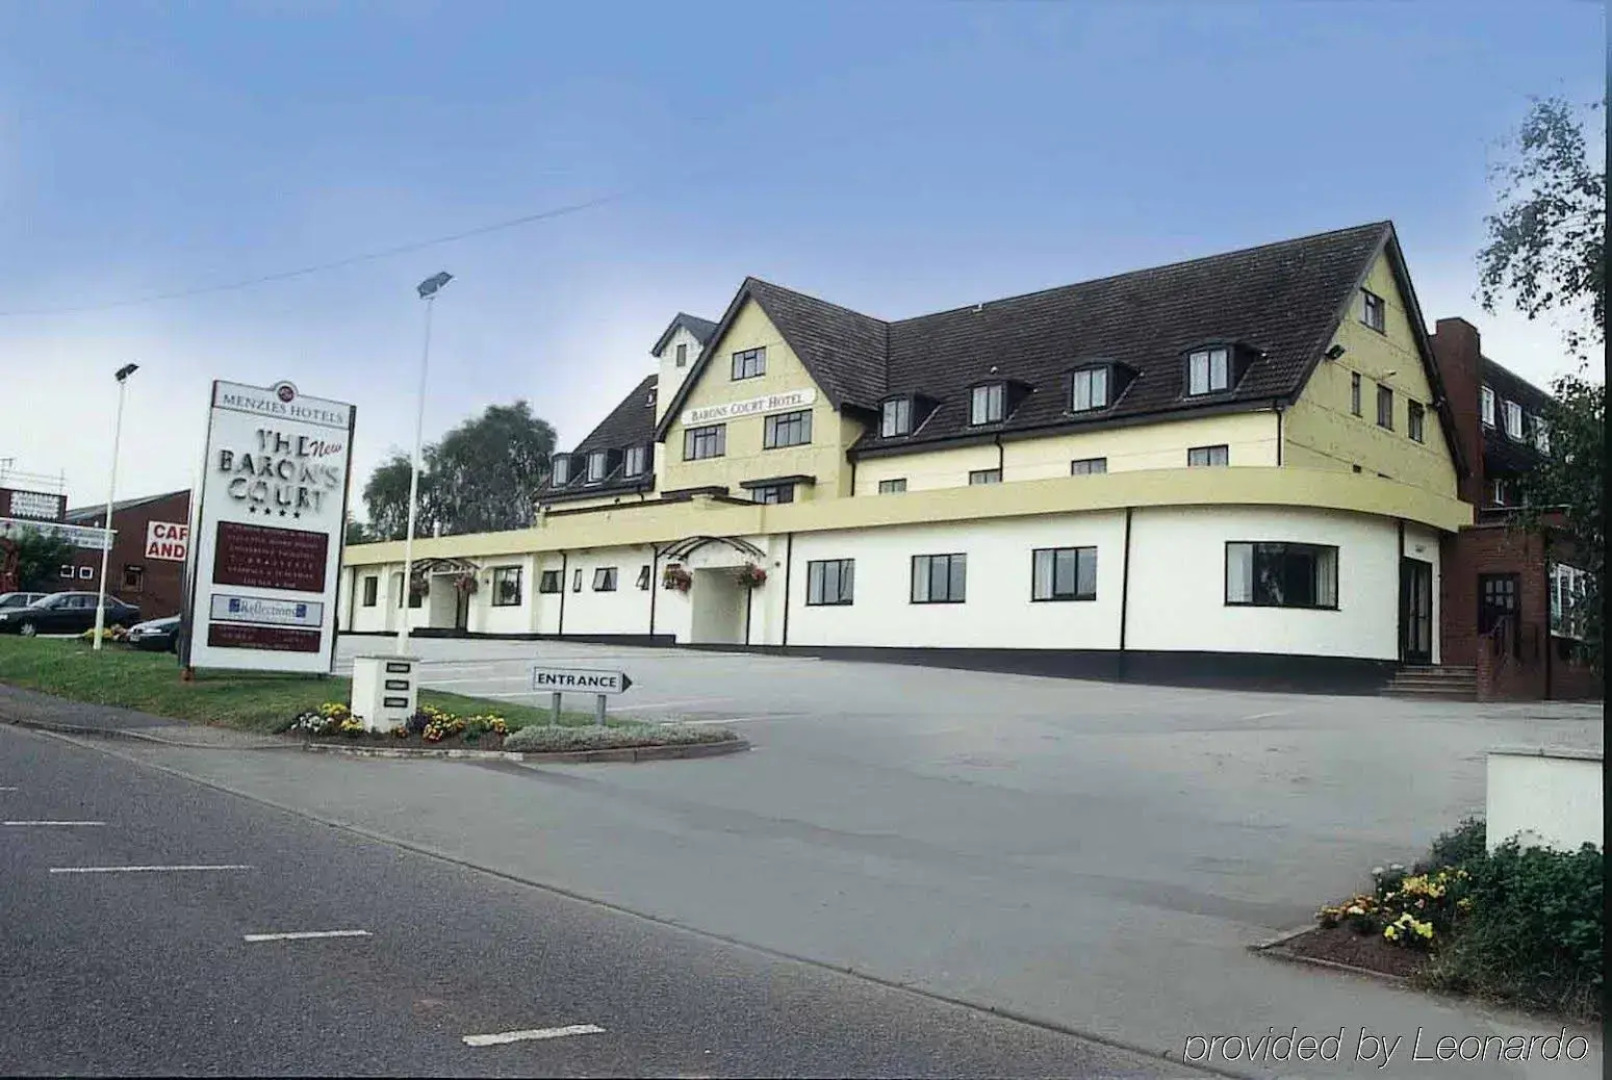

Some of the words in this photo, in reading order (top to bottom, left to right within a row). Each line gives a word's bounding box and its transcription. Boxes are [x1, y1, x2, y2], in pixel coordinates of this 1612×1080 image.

[223, 393, 288, 414] MENZIES
[290, 405, 344, 424] HOTELS
[730, 401, 765, 414] COURT
[768, 394, 806, 409] HOTEL
[256, 428, 310, 457] THE
[310, 440, 342, 458] New
[228, 477, 327, 511] COURT
[148, 541, 186, 558] AND
[537, 673, 617, 688] ENTRANCE
